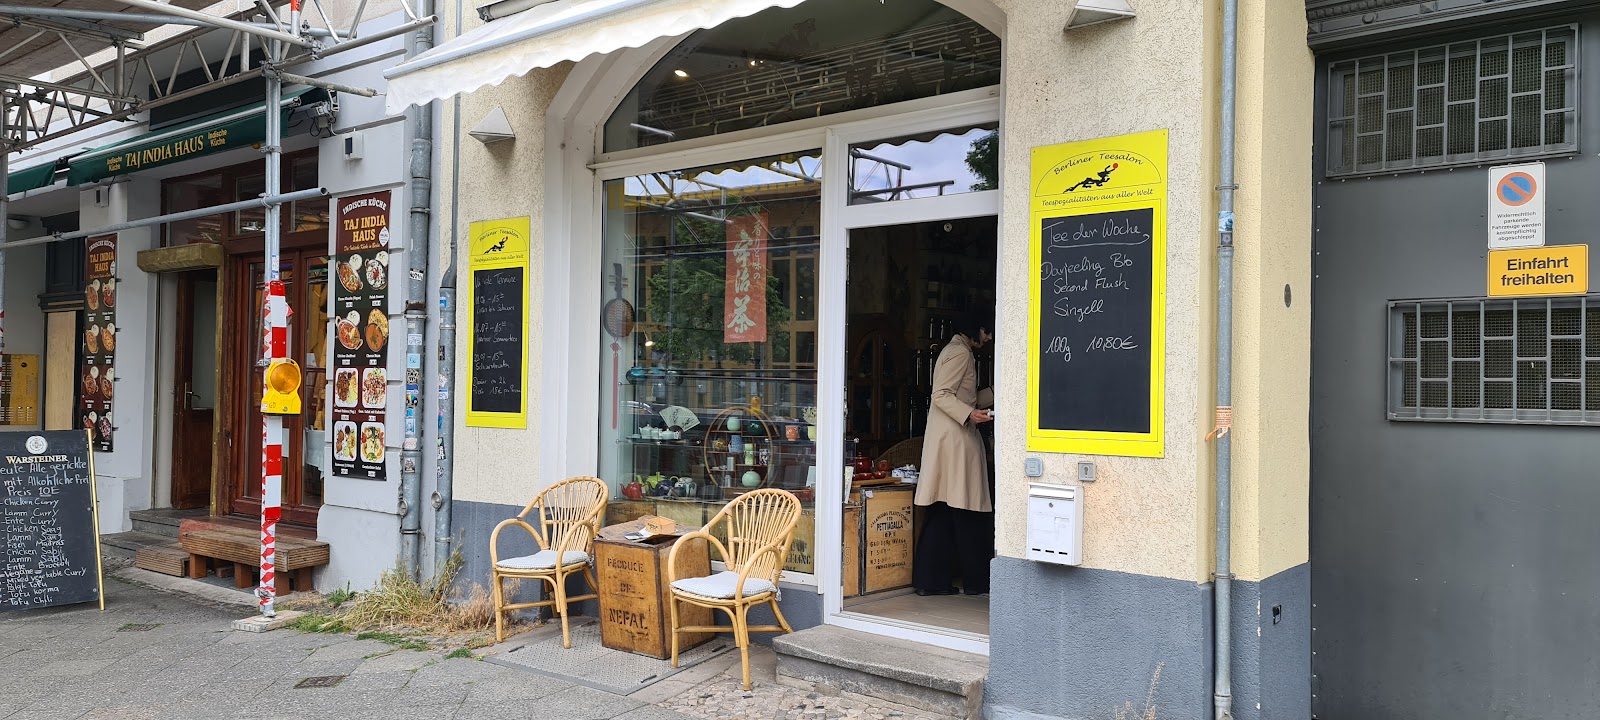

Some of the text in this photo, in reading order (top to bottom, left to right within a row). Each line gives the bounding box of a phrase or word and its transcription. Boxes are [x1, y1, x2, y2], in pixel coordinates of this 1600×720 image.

[208, 129, 228, 139] Indische
[210, 138, 226, 147] Küche
[126, 135, 204, 169] TAJ INDIA HAUS
[1054, 153, 1144, 175] Berliner Teesalon
[1042, 195, 1100, 207] Teespezialitäten
[1116, 191, 1135, 199] aller
[1136, 188, 1154, 196] Welt
[343, 197, 387, 215] INDISCHE KÜCHE
[1497, 211, 1536, 219] Widerrechtlich
[344, 214, 386, 230] TAJ INDIA
[1503, 217, 1529, 225] parkende
[1042, 219, 1141, 245] Tee der Woche
[1492, 223, 1520, 231] Fahrzeuge
[1496, 228, 1537, 236] kostenpflichtig
[353, 229, 376, 242] HAUS
[1498, 234, 1535, 242] abgeschleppt
[90, 254, 99, 262] TAJ
[1040, 253, 1133, 284] Darjeeling Bio
[1507, 256, 1569, 271] Einfahrt
[727, 228, 756, 334] 宇治茶
[1053, 273, 1130, 294] Second Flush
[1501, 272, 1574, 287] freihalten
[1045, 335, 1138, 362] 100g 10,80€
[6, 454, 68, 464] WARSTEINER
[30, 463, 48, 473] Alle
[4, 477, 22, 487] mit
[7, 486, 31, 496] Preis
[4, 498, 59, 508] Chicken Curry
[5, 508, 59, 517] Lamm Curry
[5, 517, 57, 526] Ente Curry
[877, 521, 903, 531] PETTIAGALLA
[7, 525, 38, 533] Chicken
[7, 533, 31, 541] Lamm
[7, 541, 26, 549] Fisch
[7, 548, 37, 556] Chicken
[7, 563, 26, 571] Ente
[607, 558, 644, 573] PRODUCE
[4, 569, 33, 578] Vegane
[64, 567, 86, 576] Curry
[609, 608, 648, 630] NEPAL
